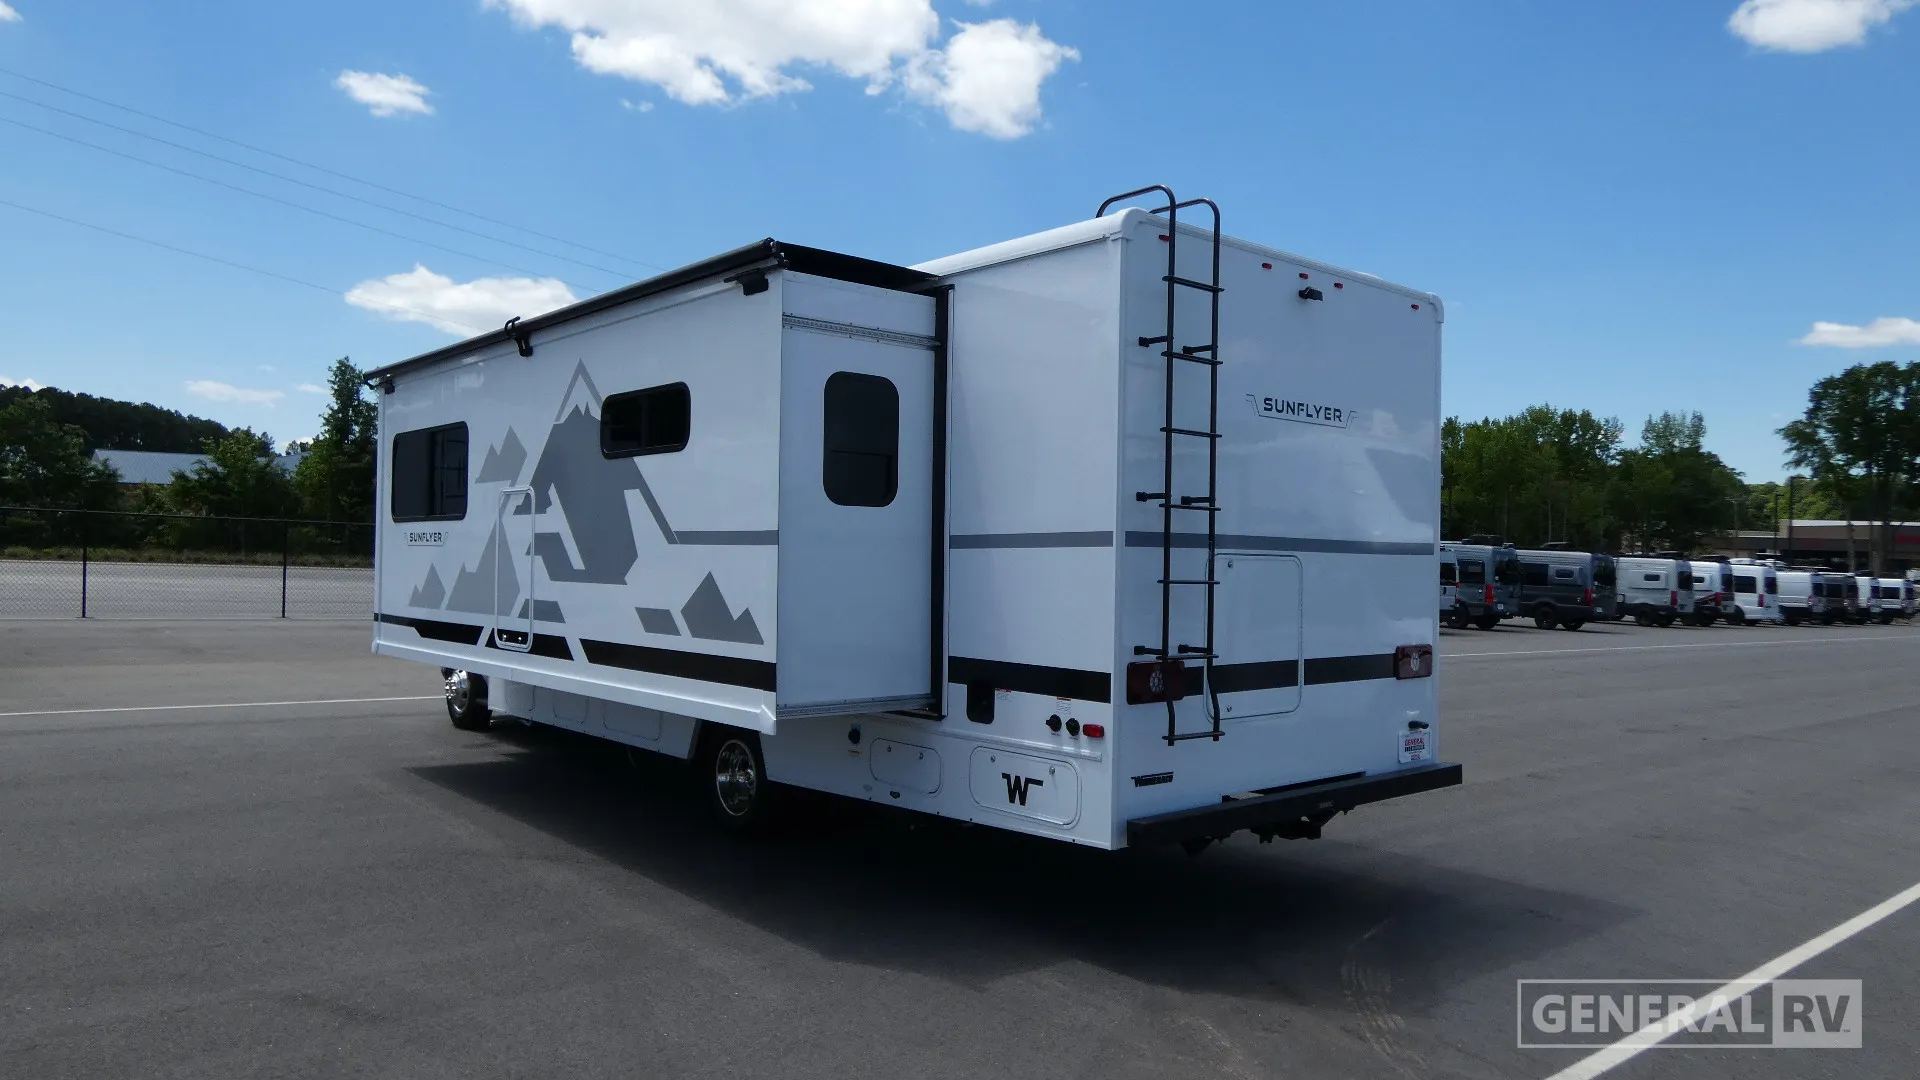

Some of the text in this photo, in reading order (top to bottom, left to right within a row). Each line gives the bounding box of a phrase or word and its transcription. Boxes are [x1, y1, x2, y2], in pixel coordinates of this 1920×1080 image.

[1263, 397, 1342, 422] SUNFLYER
[409, 532, 442, 542] SUNFLYER
[1001, 772, 1044, 807] W
